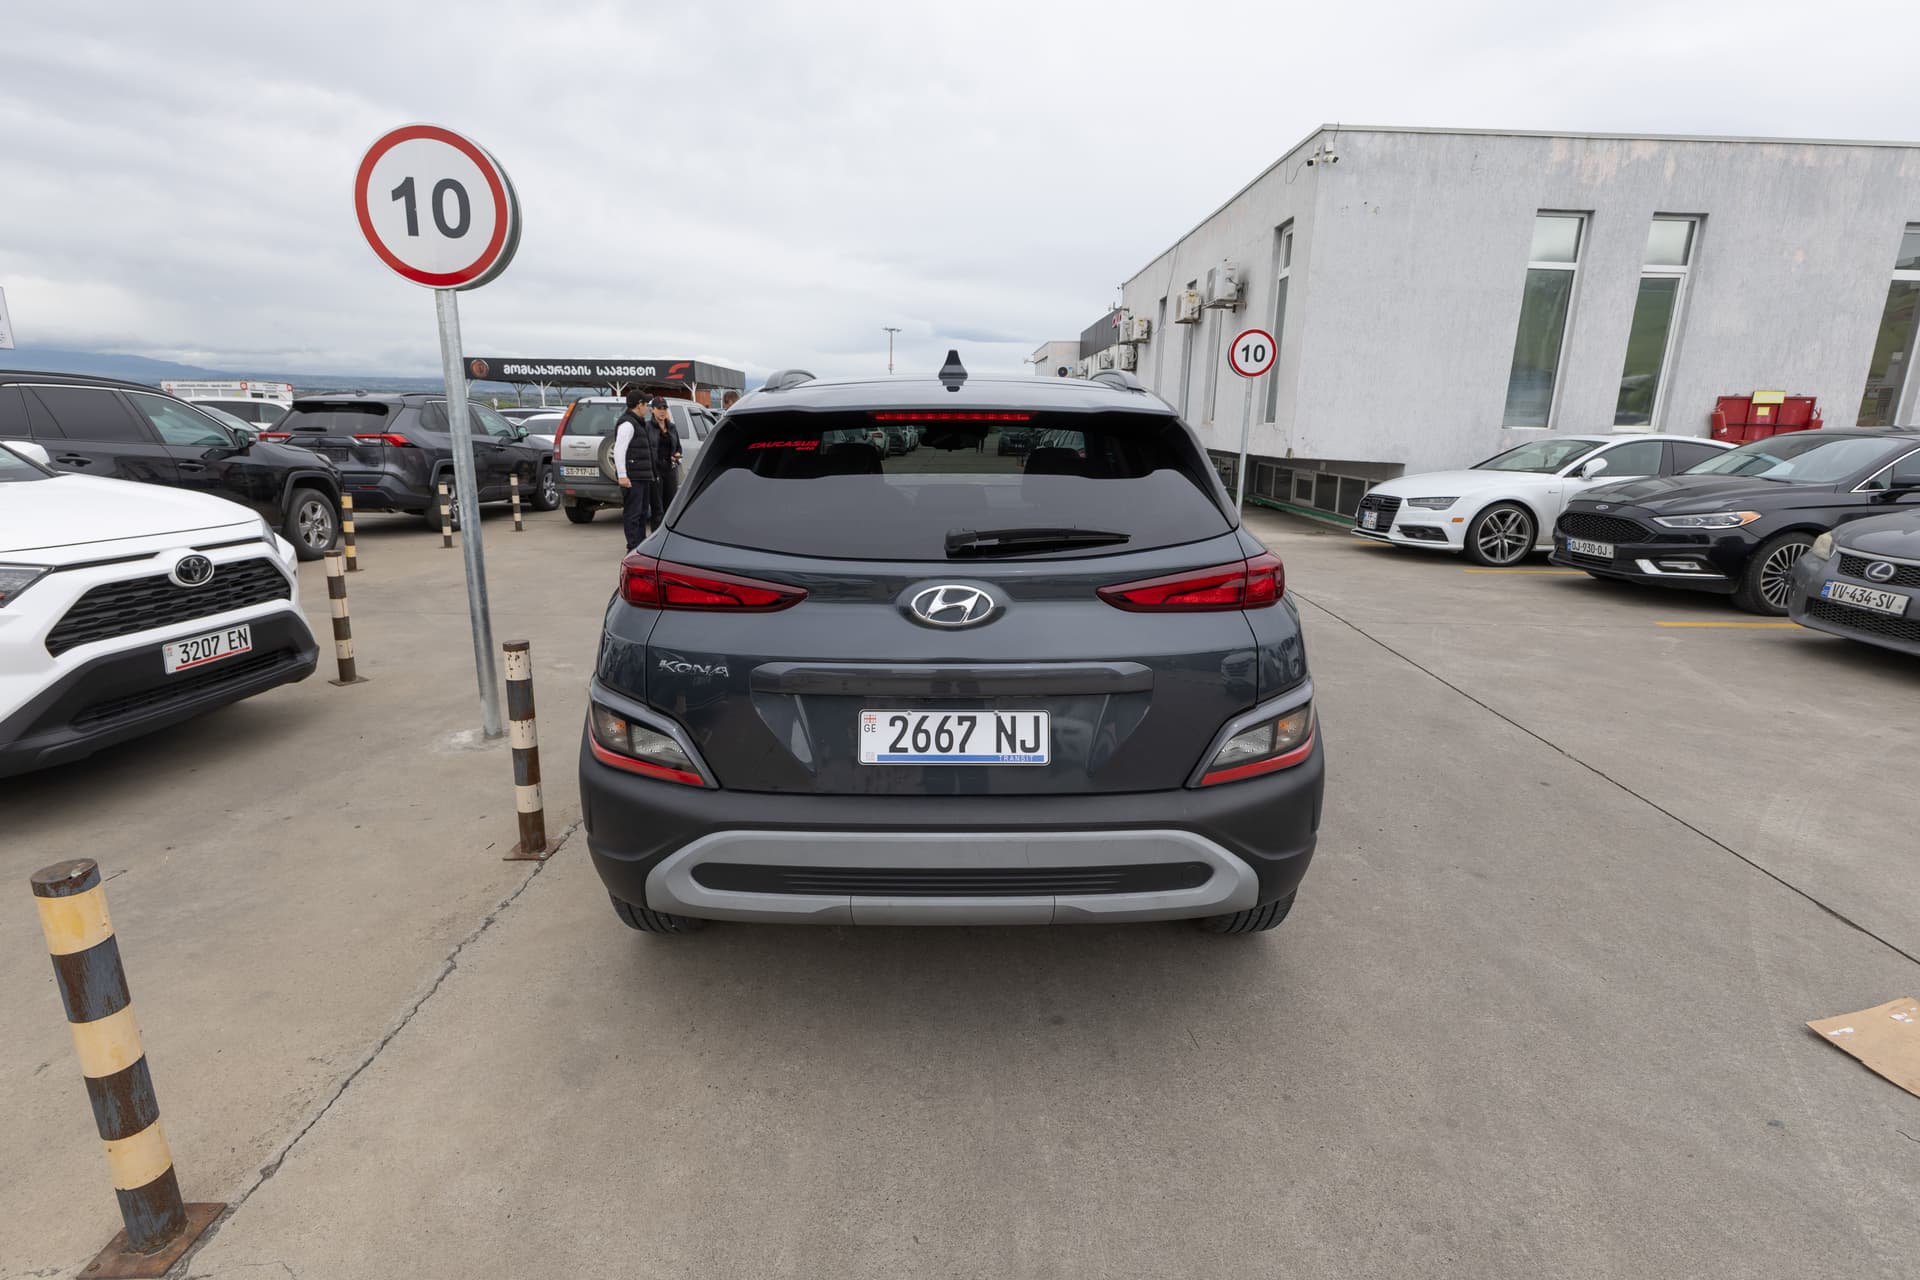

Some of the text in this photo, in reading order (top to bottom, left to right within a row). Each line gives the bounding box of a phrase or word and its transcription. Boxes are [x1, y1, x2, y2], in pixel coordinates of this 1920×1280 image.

[391, 176, 471, 239] 10
[1241, 344, 1266, 363] 10
[503, 364, 656, 377] მომსახურების სააგენტო
[1832, 583, 1897, 610] VV-434-SV
[179, 628, 249, 664] 3207 EN
[659, 659, 729, 678] KONA
[864, 723, 877, 733] GE
[889, 715, 1041, 754] 2667 NJ
